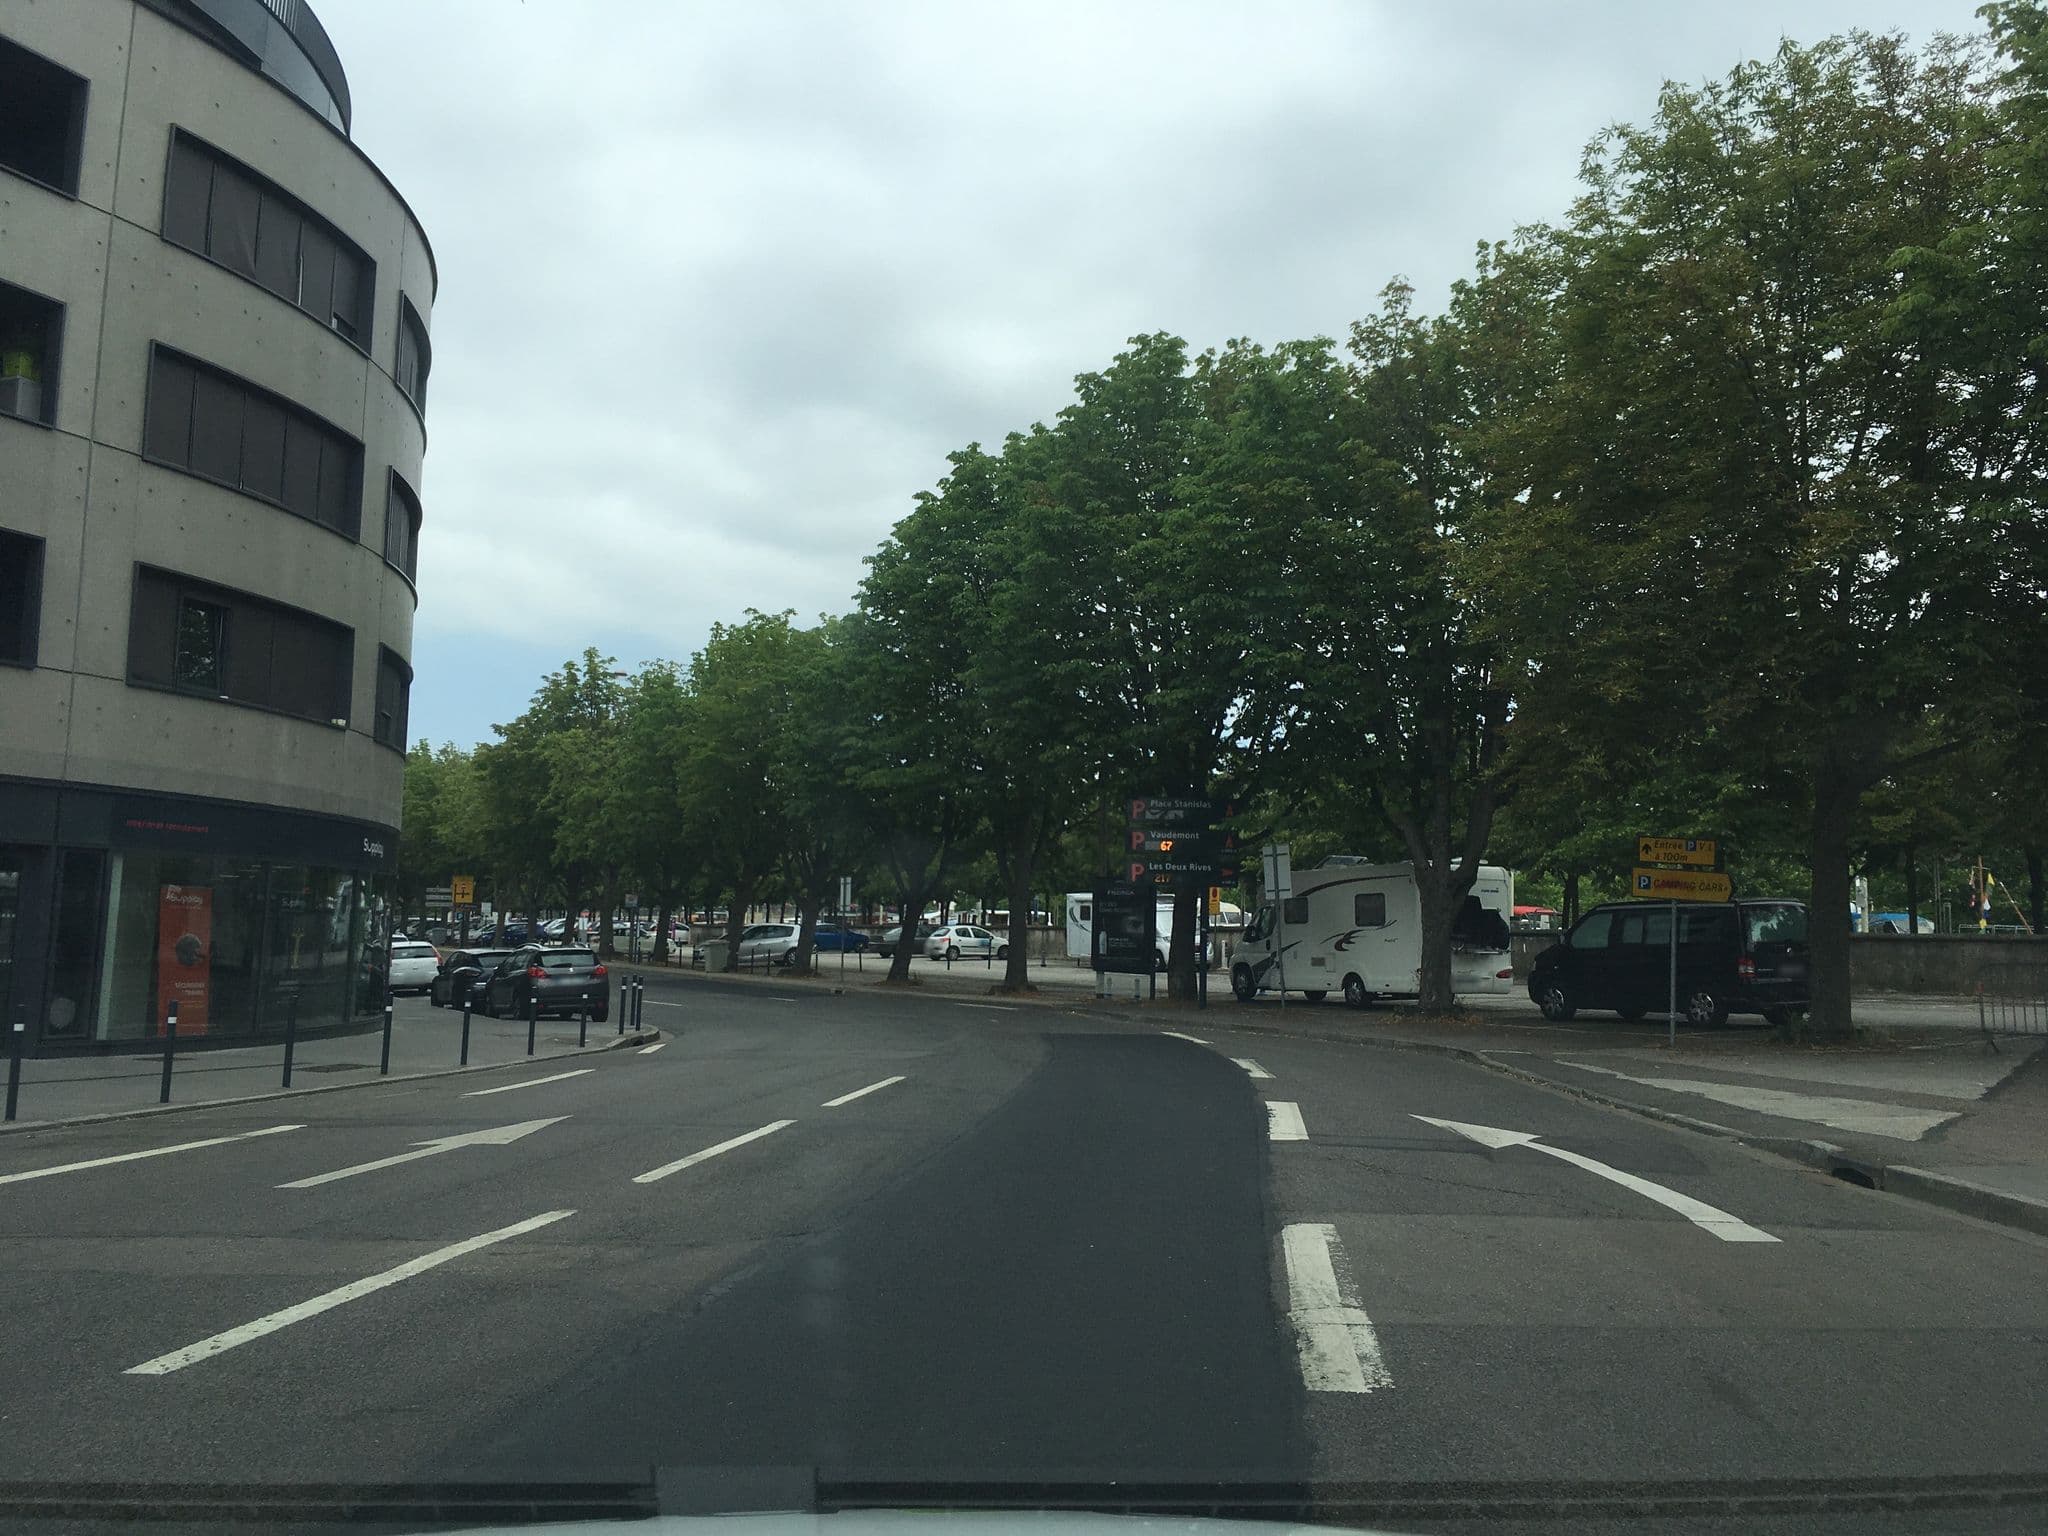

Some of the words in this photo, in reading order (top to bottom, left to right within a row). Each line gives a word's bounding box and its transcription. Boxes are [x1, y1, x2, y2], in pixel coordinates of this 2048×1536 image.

[1174, 799, 1212, 810] Stanislas
[1150, 830, 1200, 840] Vaudemont
[1160, 840, 1174, 851] 67
[1149, 862, 1163, 870] Les
[1165, 862, 1188, 871] Deux
[1189, 863, 1212, 872] Rives
